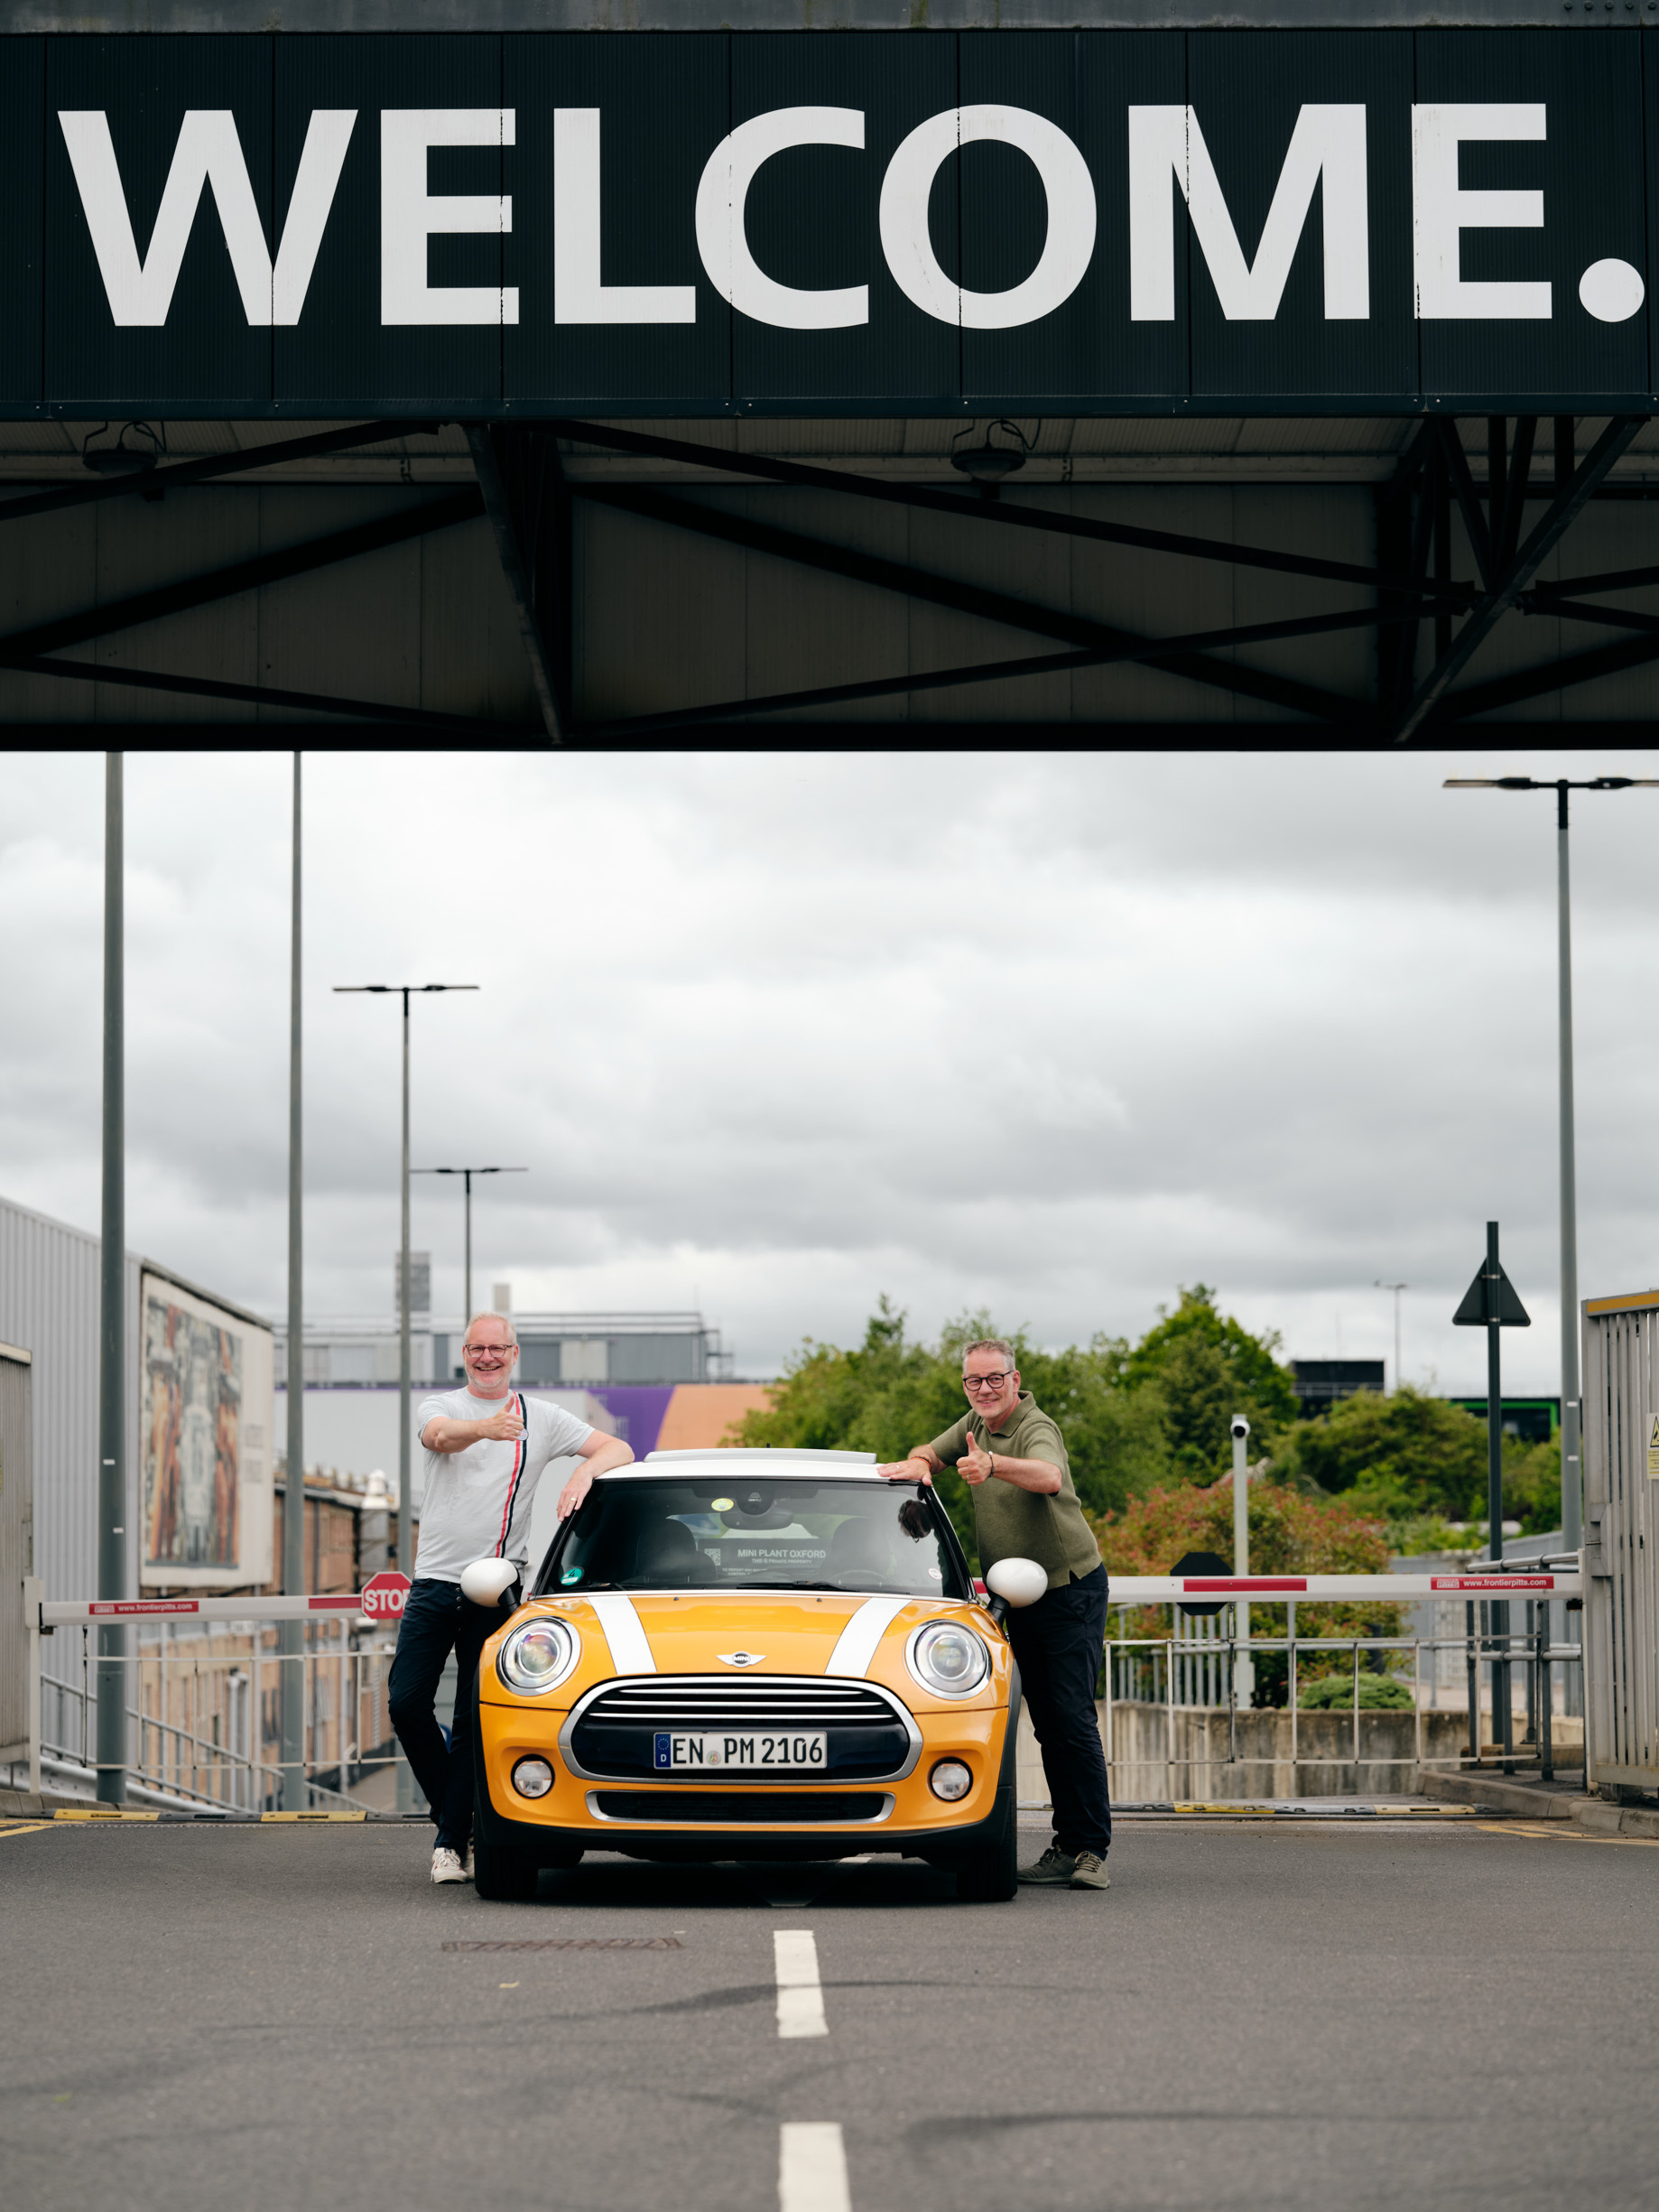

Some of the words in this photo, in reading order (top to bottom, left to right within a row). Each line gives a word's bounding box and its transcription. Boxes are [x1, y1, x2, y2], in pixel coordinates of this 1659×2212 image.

[57, 103, 1645, 329] WELCOME.
[737, 1549, 756, 1557] MINI
[758, 1549, 788, 1557] PLANT
[790, 1549, 826, 1558] OXFORD
[1463, 1578, 1546, 1588] www.frontierpitts.com
[118, 1603, 192, 1612] www.frontierpitts.com
[672, 1738, 703, 1764] EN
[724, 1738, 754, 1763] PM
[762, 1738, 823, 1763] 2106
[661, 1754, 666, 1762] D
